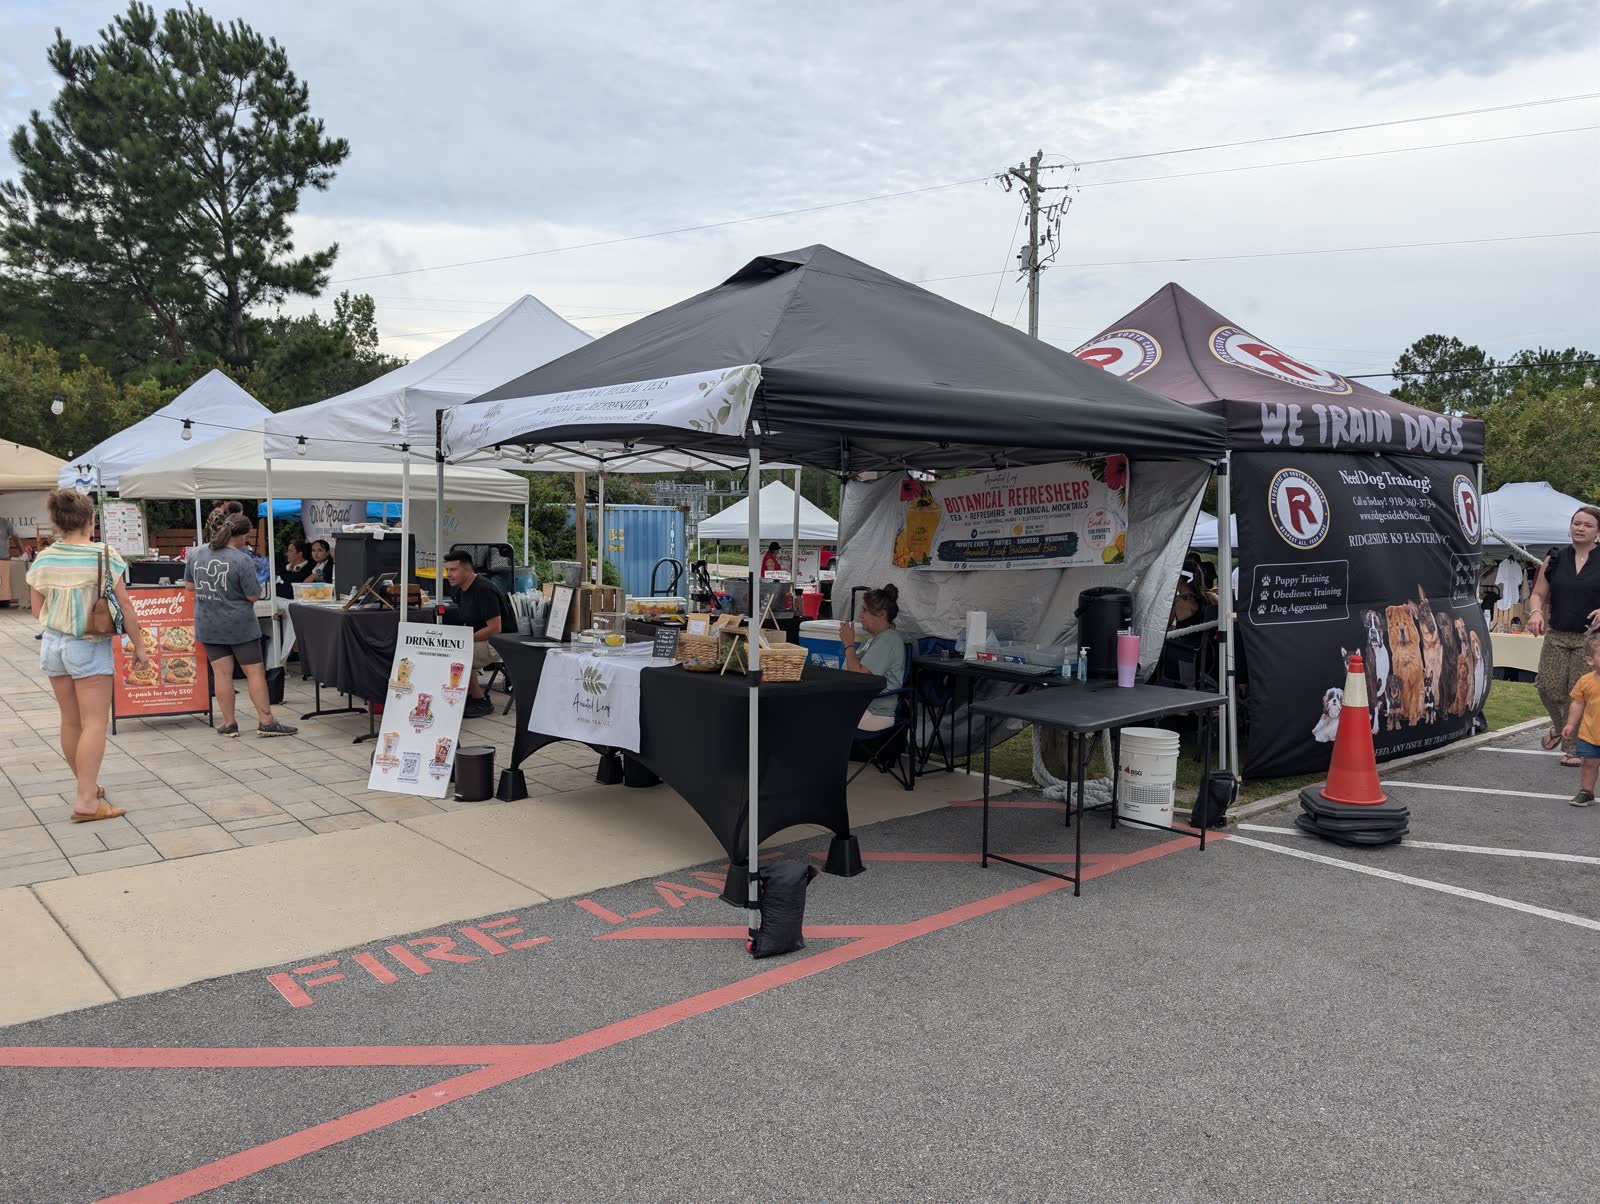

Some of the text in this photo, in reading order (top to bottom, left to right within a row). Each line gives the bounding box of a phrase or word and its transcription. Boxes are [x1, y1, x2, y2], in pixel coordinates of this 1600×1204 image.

[1118, 331, 1156, 366] NORTH CAROLINA
[1261, 402, 1464, 456] WE TRAIN DOGS
[1271, 476, 1283, 504] RIDGESIDE
[1289, 471, 1304, 479] NORTH
[1306, 478, 1325, 503] CAROLINA
[1338, 470, 1360, 485] Need
[1358, 470, 1386, 489] Dog
[943, 480, 1090, 514] BOTANICAL REFRESHERS
[310, 503, 353, 528] Dirt Road
[969, 509, 1006, 520] REFRESHERS
[1013, 505, 1050, 516] BOTANICAL
[1051, 500, 1089, 513] MOCKTAILS
[1285, 487, 1318, 534] R
[1461, 491, 1478, 533] R
[19, 516, 37, 527] LLC
[1017, 537, 1040, 545] SHOWERS
[1045, 535, 1069, 543] WEDDINGS
[1279, 525, 1297, 543] RESPECT
[1348, 533, 1390, 547] RIDGESIDE
[1390, 533, 1403, 544] K9
[1009, 544, 1040, 555] Botanical
[1042, 543, 1057, 552] Bar
[1275, 574, 1329, 587] Puppy Training
[1273, 586, 1342, 599] Obedience Training
[169, 603, 183, 615] Co
[1270, 602, 1328, 615] Dog Aggression
[405, 636, 435, 647] DRINK
[436, 638, 465, 650] MENU
[128, 691, 152, 699] 6-pack
[164, 689, 178, 697] only
[1424, 737, 1433, 746] WE
[1433, 734, 1448, 744] TRAIN
[267, 916, 554, 1008] FIRE
